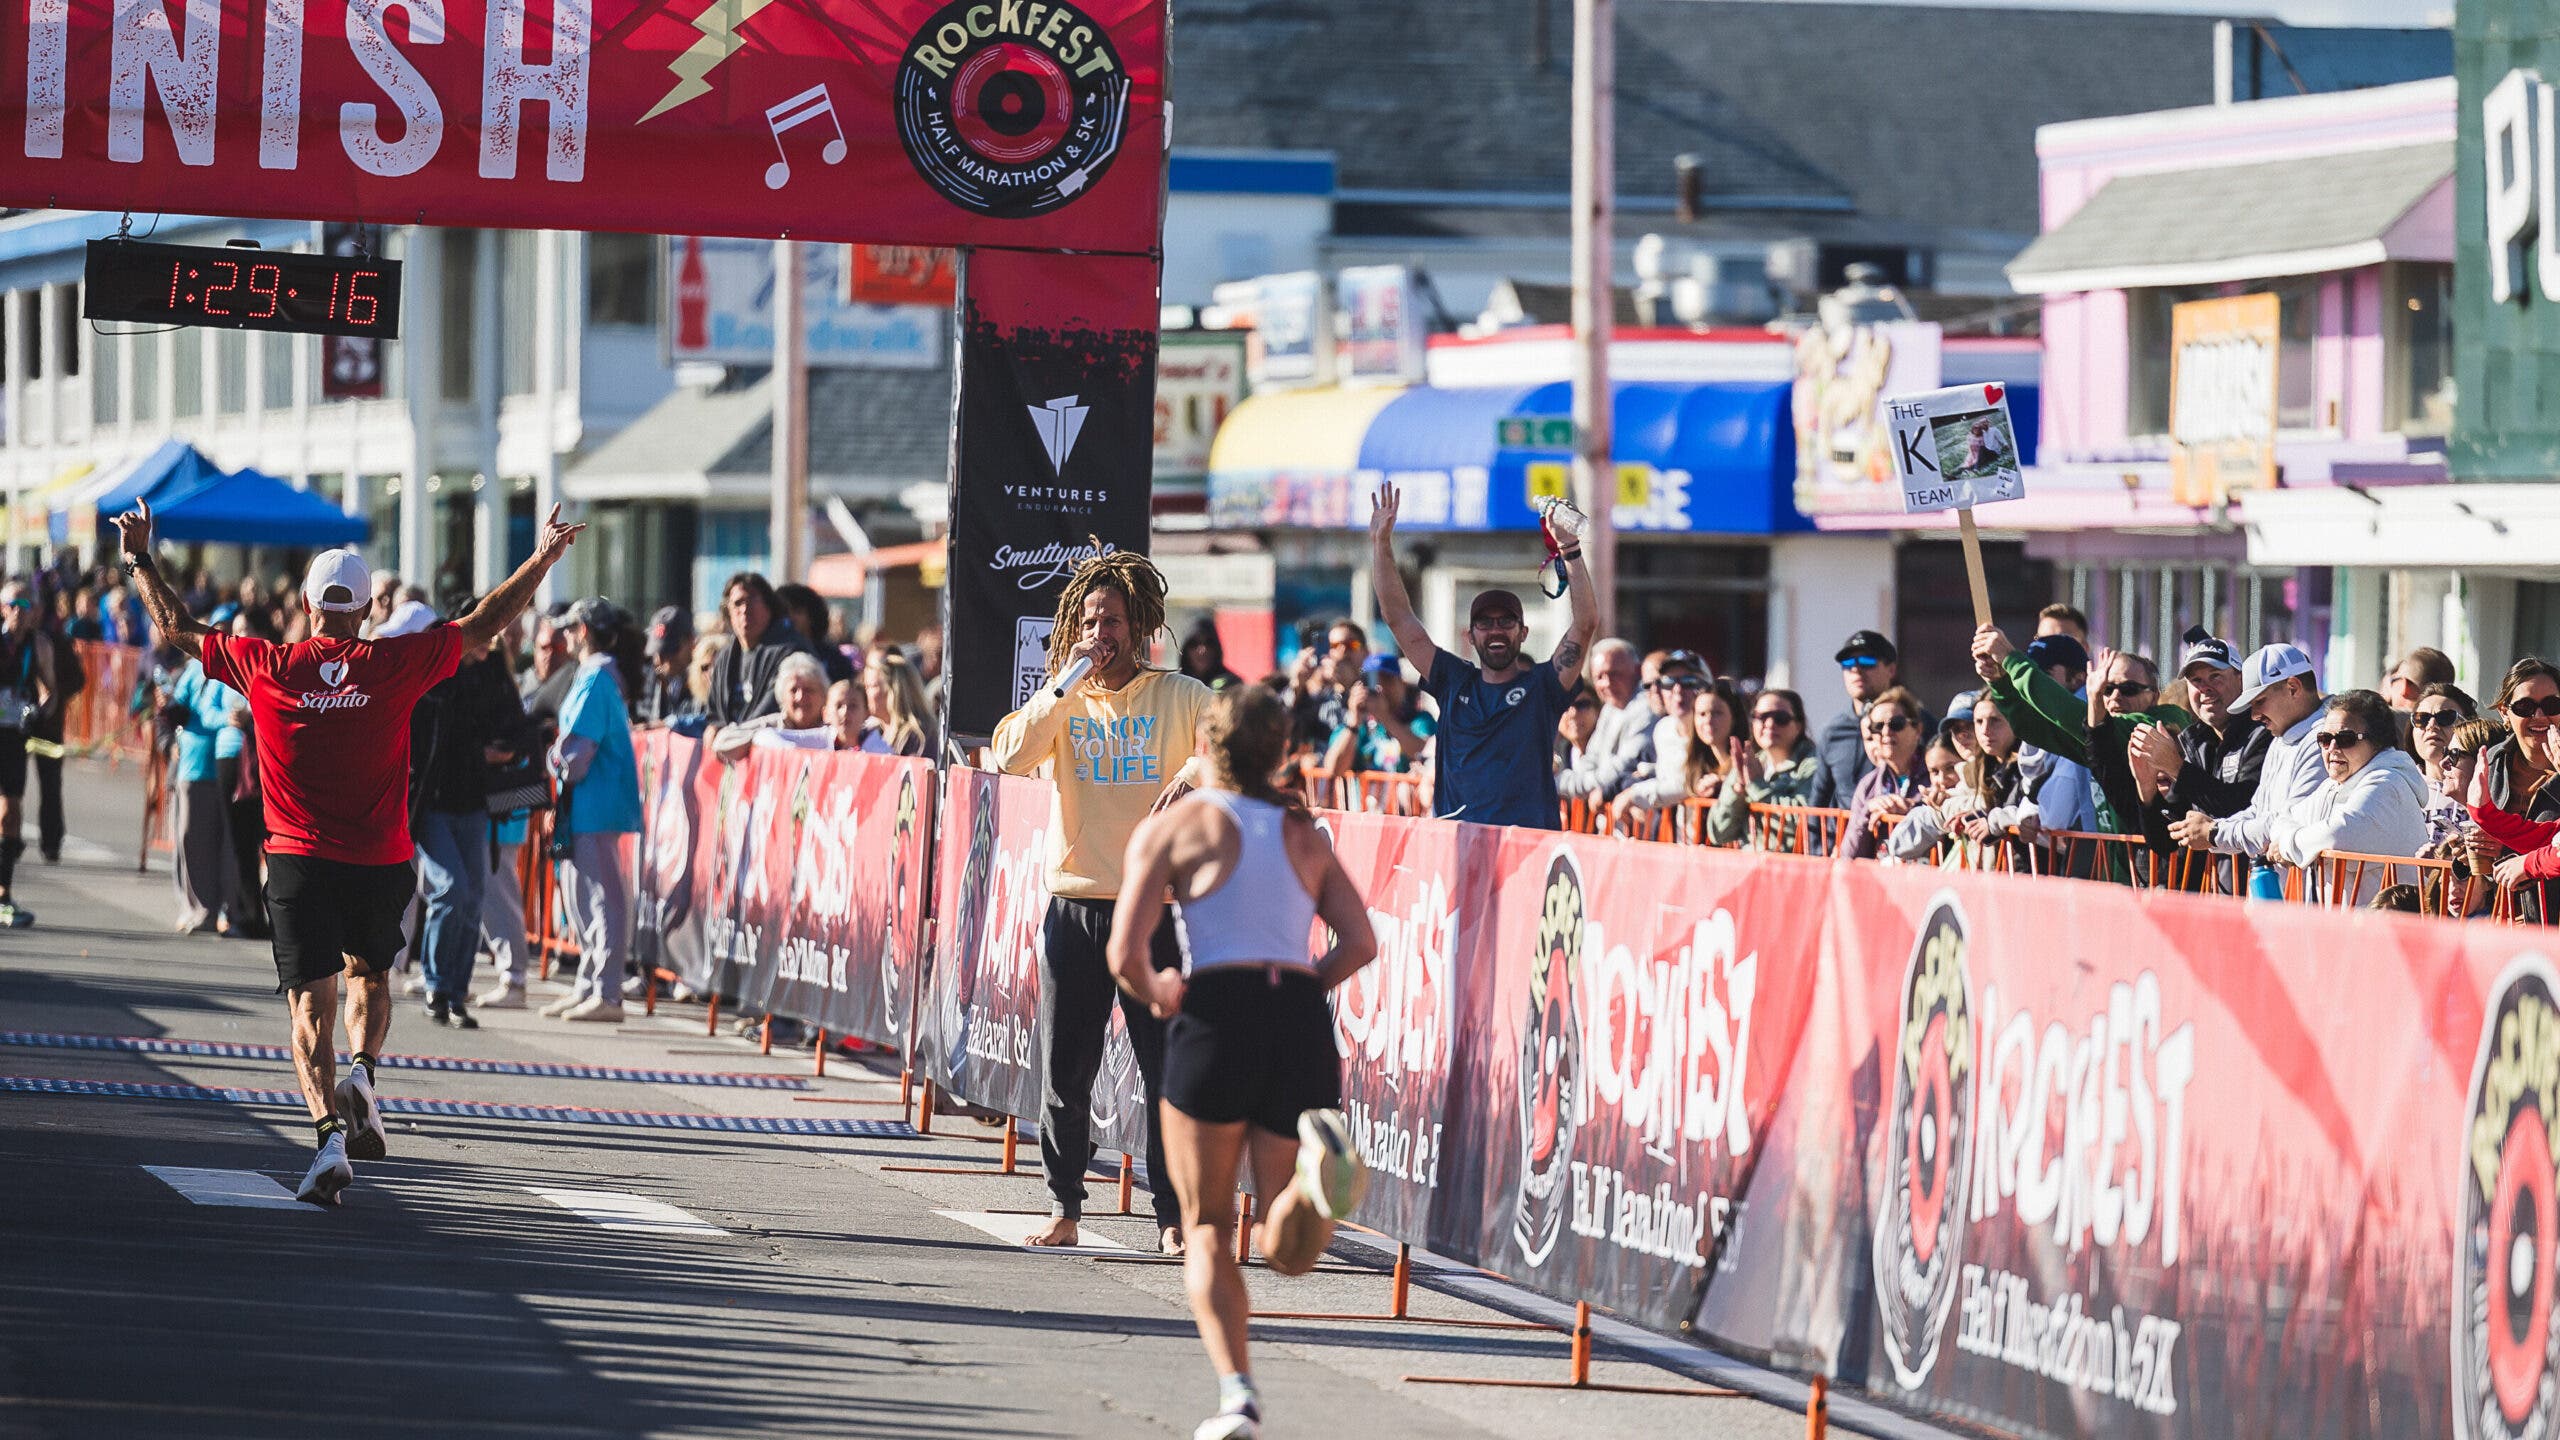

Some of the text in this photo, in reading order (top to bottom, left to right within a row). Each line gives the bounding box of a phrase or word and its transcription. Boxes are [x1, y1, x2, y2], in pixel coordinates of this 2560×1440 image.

[913, 0, 1114, 79] ROCKFEST
[927, 111, 1097, 187] HALF MARATHON & 5K
[1890, 403, 1925, 421] THE
[1898, 425, 1939, 475] K
[1004, 484, 1107, 502] VENTURES
[1908, 487, 1954, 507] TEAM
[1017, 502, 1092, 515] ENDURANCE
[296, 691, 372, 713] Saputo
[1070, 715, 1157, 740] ENJOY
[1071, 735, 1147, 760] YOUR
[1093, 756, 1160, 782] LIFE
